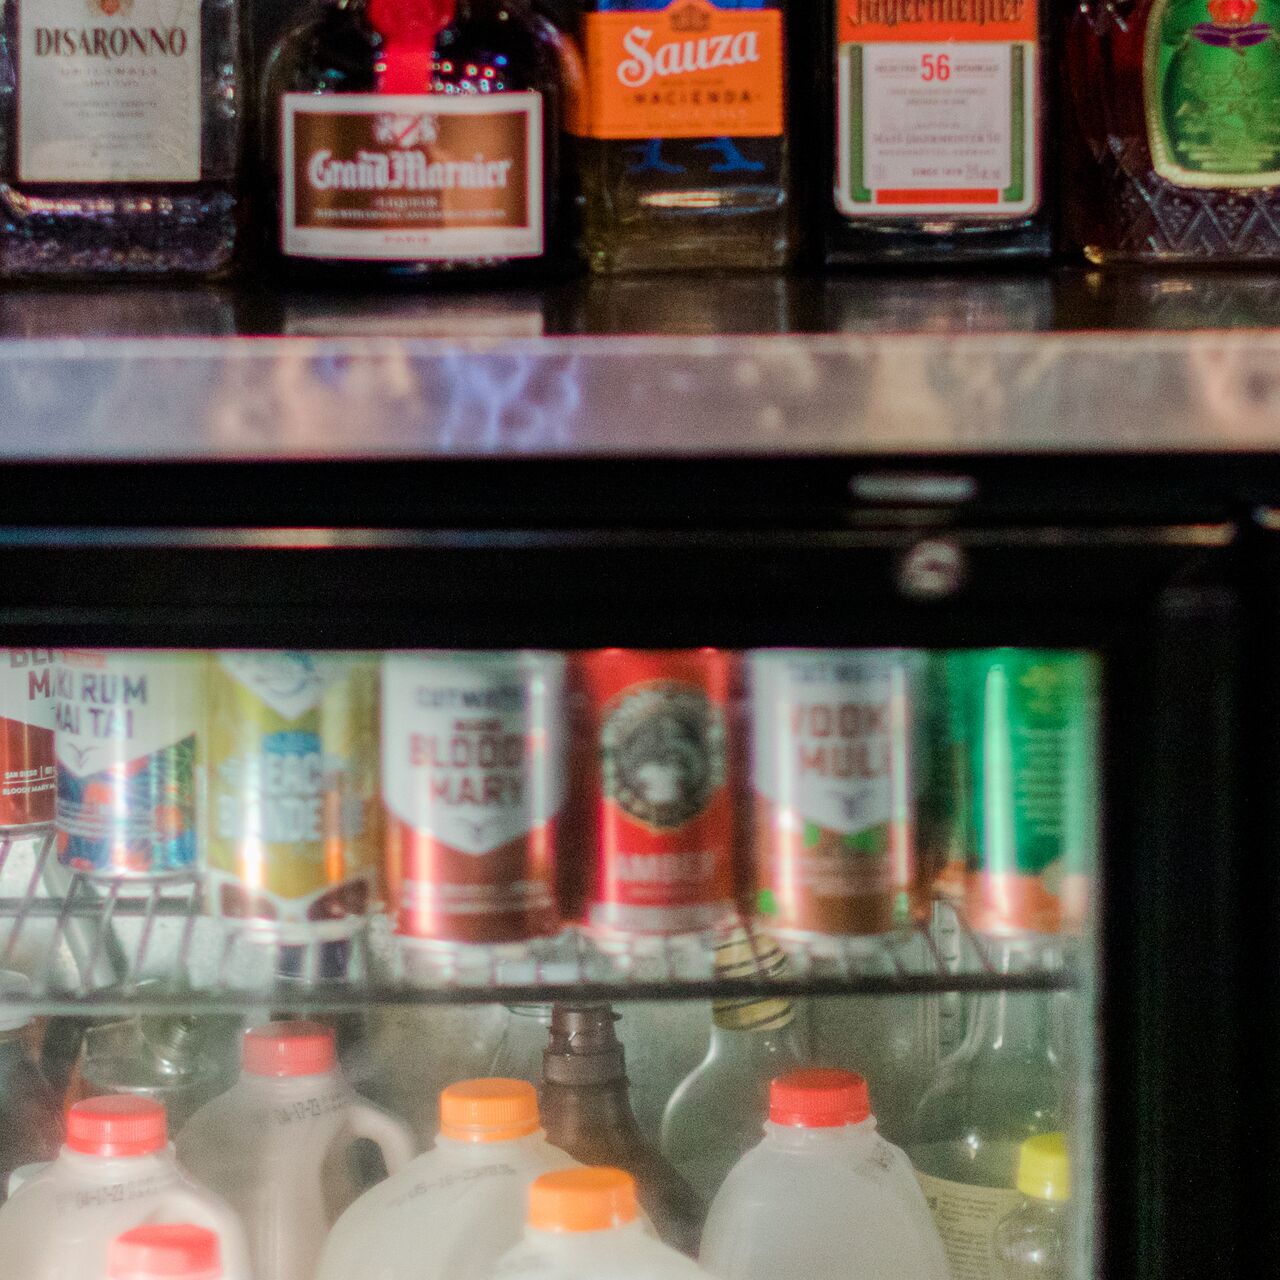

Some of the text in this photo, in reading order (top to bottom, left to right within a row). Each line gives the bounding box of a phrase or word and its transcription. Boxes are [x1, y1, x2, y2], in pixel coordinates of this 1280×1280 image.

[33, 26, 188, 60] DISARONNO
[616, 25, 761, 88] Sauza
[920, 53, 951, 83] 56
[80, 672, 148, 704] RUM
[90, 708, 134, 739] TAI
